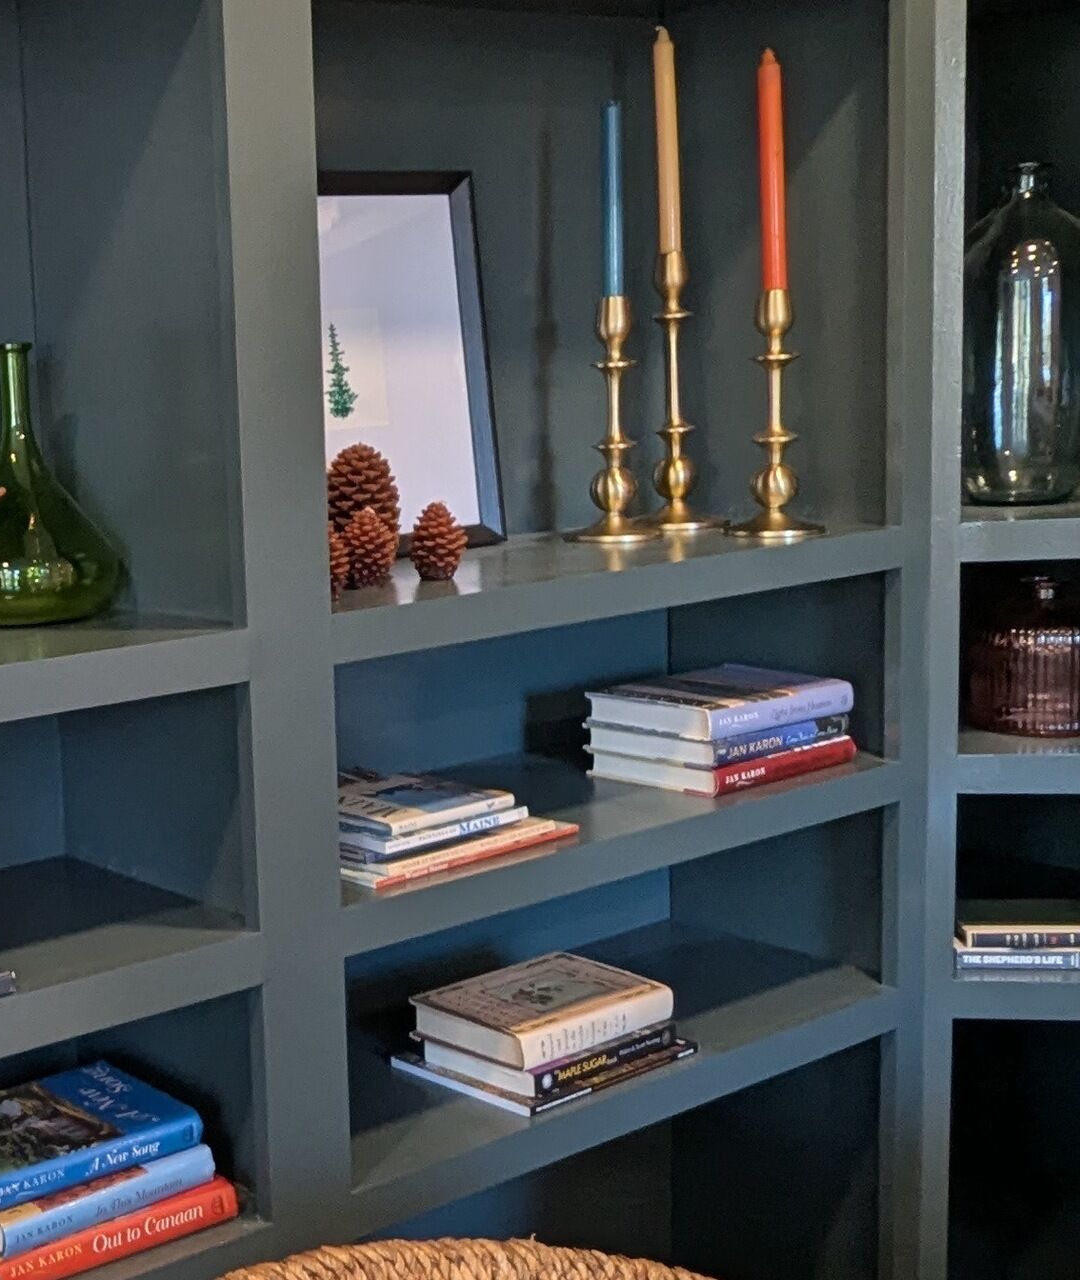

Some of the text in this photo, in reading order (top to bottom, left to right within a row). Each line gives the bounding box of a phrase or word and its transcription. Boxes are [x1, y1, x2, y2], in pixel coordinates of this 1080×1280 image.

[726, 736, 784, 760] JAN KARON
[458, 815, 501, 835] MAINE
[1042, 955, 1064, 965] LIFE
[556, 1062, 581, 1081] MAPLE
[581, 1055, 609, 1074] SUGAR
[131, 1139, 161, 1158] Song
[22, 1168, 66, 1191] KARON
[15, 1214, 74, 1244] JAN KARON
[92, 1204, 204, 1254] Out to Canaan
[10, 1242, 83, 1279] JAN KARON
